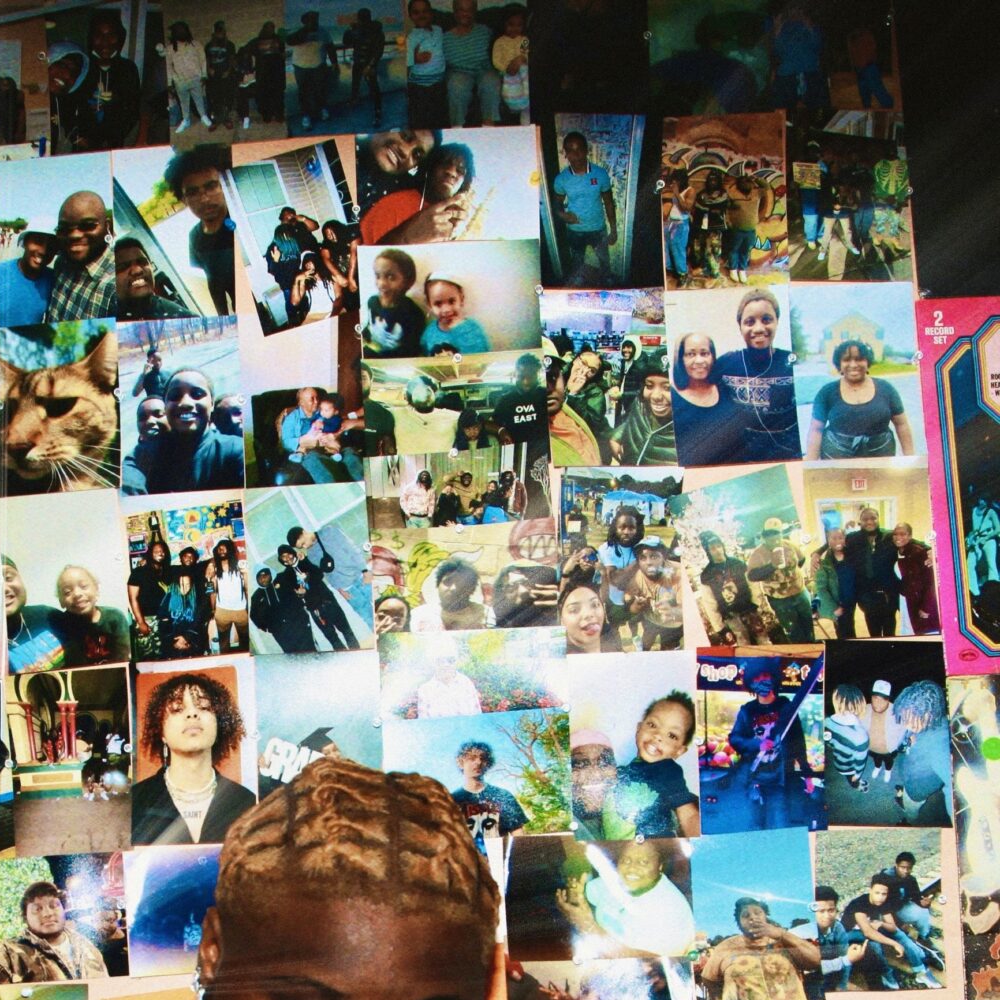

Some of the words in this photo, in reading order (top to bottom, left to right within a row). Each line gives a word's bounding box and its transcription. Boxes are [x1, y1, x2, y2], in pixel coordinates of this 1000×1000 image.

[933, 311, 944, 327] 2
[925, 327, 955, 335] RECORD
[933, 336, 947, 344] SET
[515, 404, 535, 413] OVA
[513, 413, 537, 424] EAST
